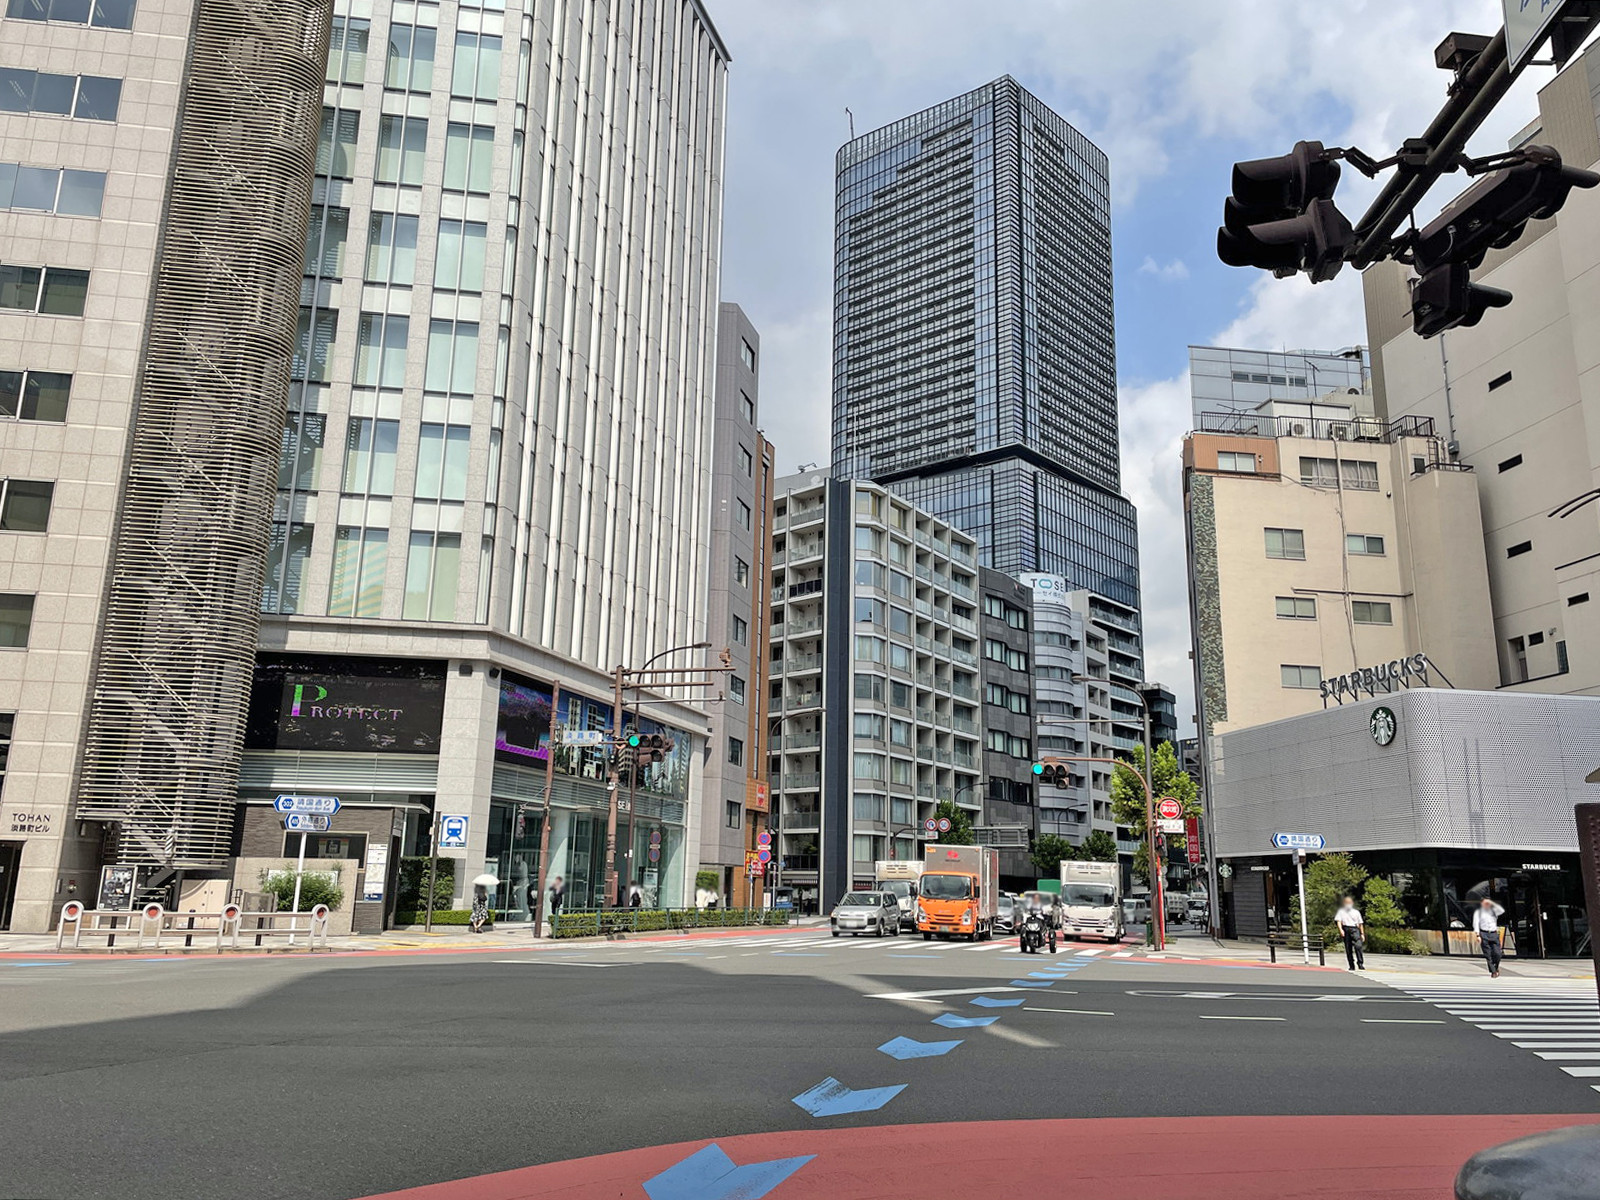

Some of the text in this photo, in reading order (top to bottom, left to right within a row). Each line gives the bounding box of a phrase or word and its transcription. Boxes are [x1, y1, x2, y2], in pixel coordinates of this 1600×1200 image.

[1320, 653, 1427, 699] STARBUCKS
[297, 798, 331, 807] 靖国通り
[12, 813, 51, 822] TOHAN
[11, 824, 50, 833] 淡路町ビル
